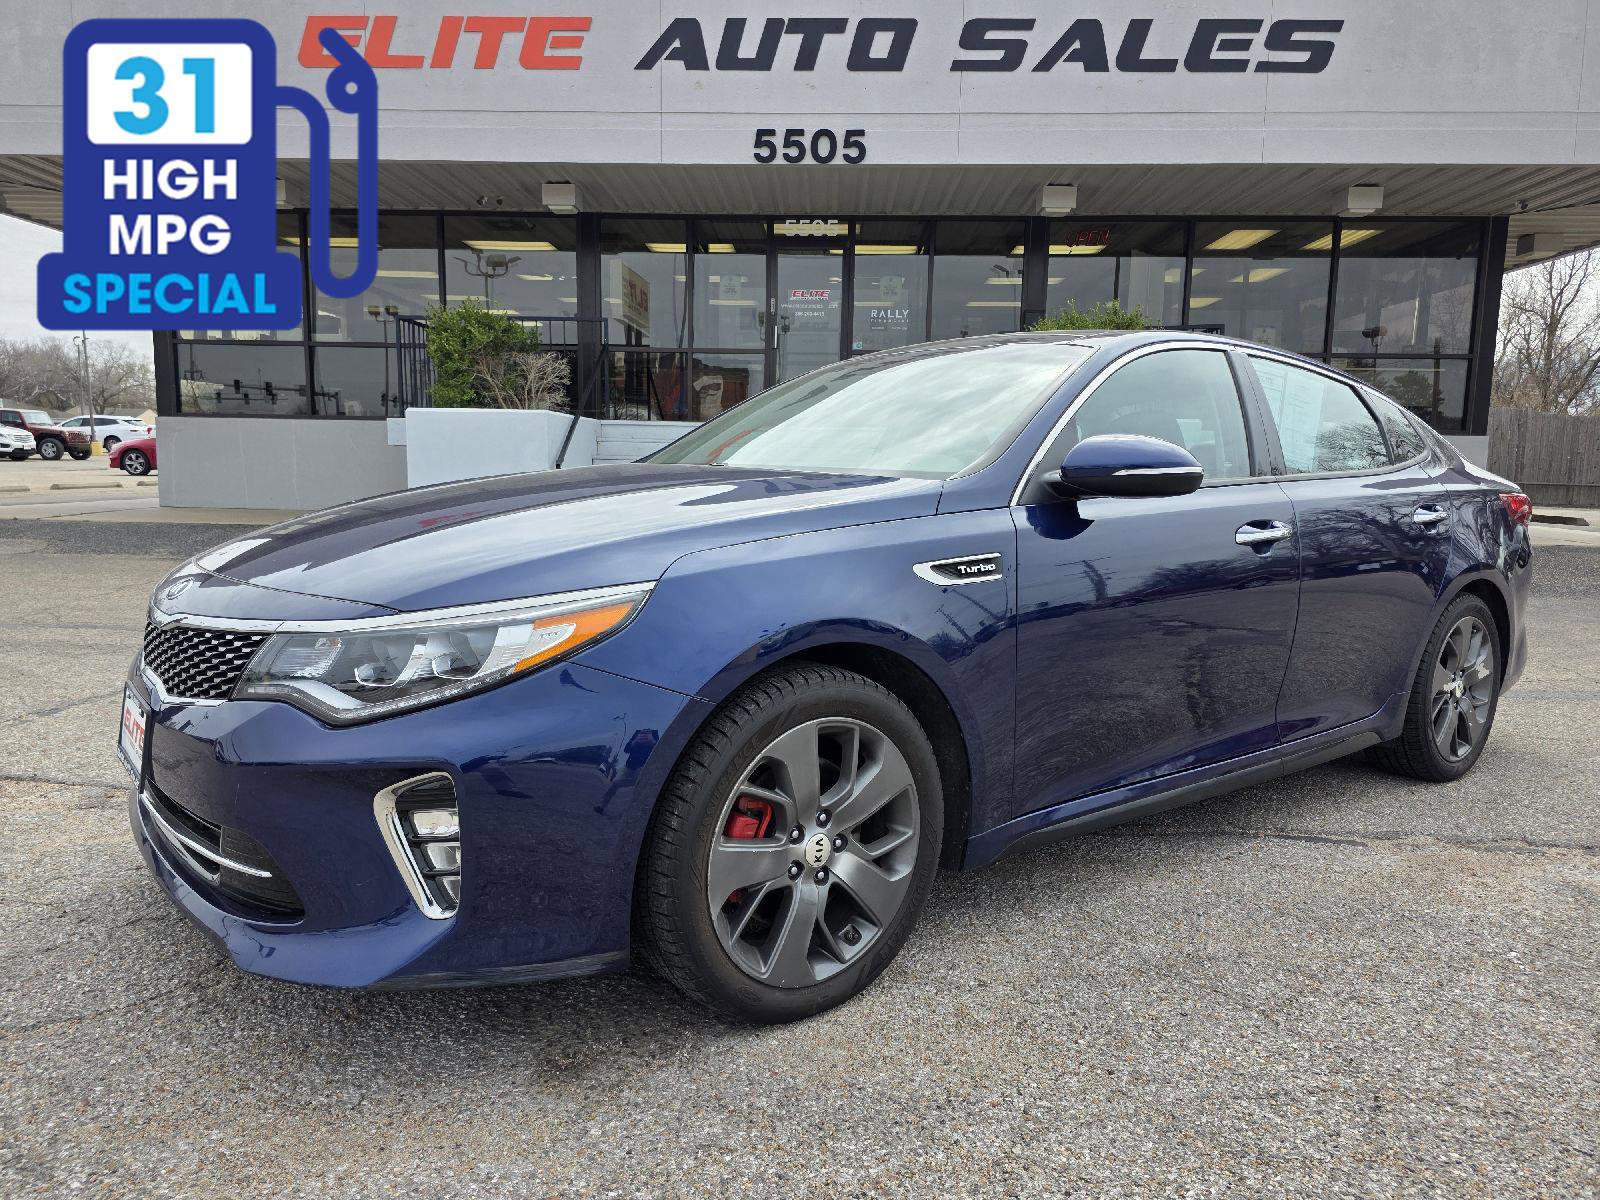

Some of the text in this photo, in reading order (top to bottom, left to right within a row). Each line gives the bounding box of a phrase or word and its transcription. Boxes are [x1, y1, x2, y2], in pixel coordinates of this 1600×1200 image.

[298, 16, 1344, 73] ELITE AUTO SALES
[753, 128, 866, 164] 5505
[791, 289, 830, 298] ELITE
[871, 309, 909, 318] RALLY
[957, 563, 996, 574] Turbo
[814, 838, 823, 863] KIA
